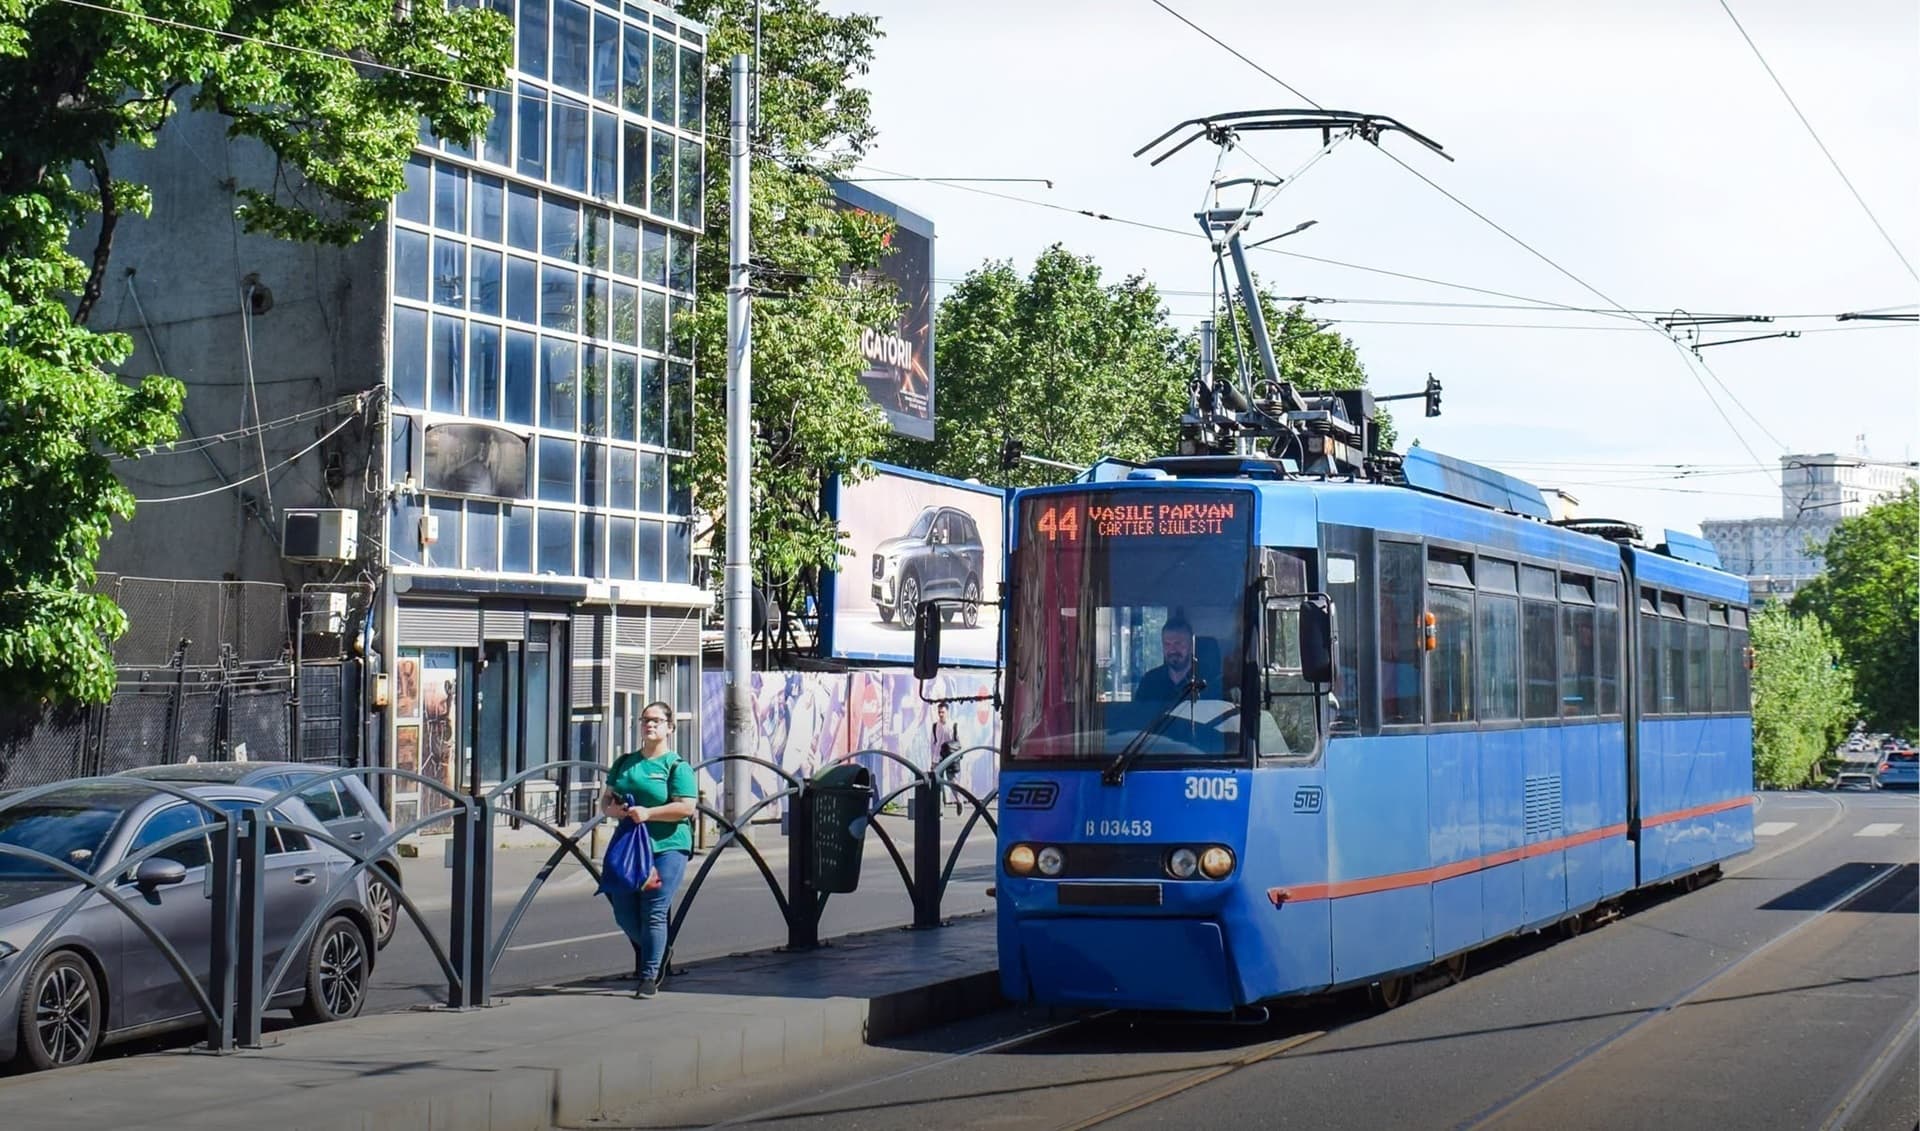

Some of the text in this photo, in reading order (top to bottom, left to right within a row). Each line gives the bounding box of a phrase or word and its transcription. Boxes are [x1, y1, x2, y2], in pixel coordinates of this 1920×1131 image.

[1088, 503, 1234, 520] VASILE PARVAN
[1037, 506, 1078, 540] 44
[1098, 519, 1223, 535] CARTIER GIULESTI
[1005, 785, 1054, 806] STB
[1184, 776, 1238, 800] 3005
[1293, 789, 1321, 810] STB
[1086, 820, 1152, 836] B 03453
